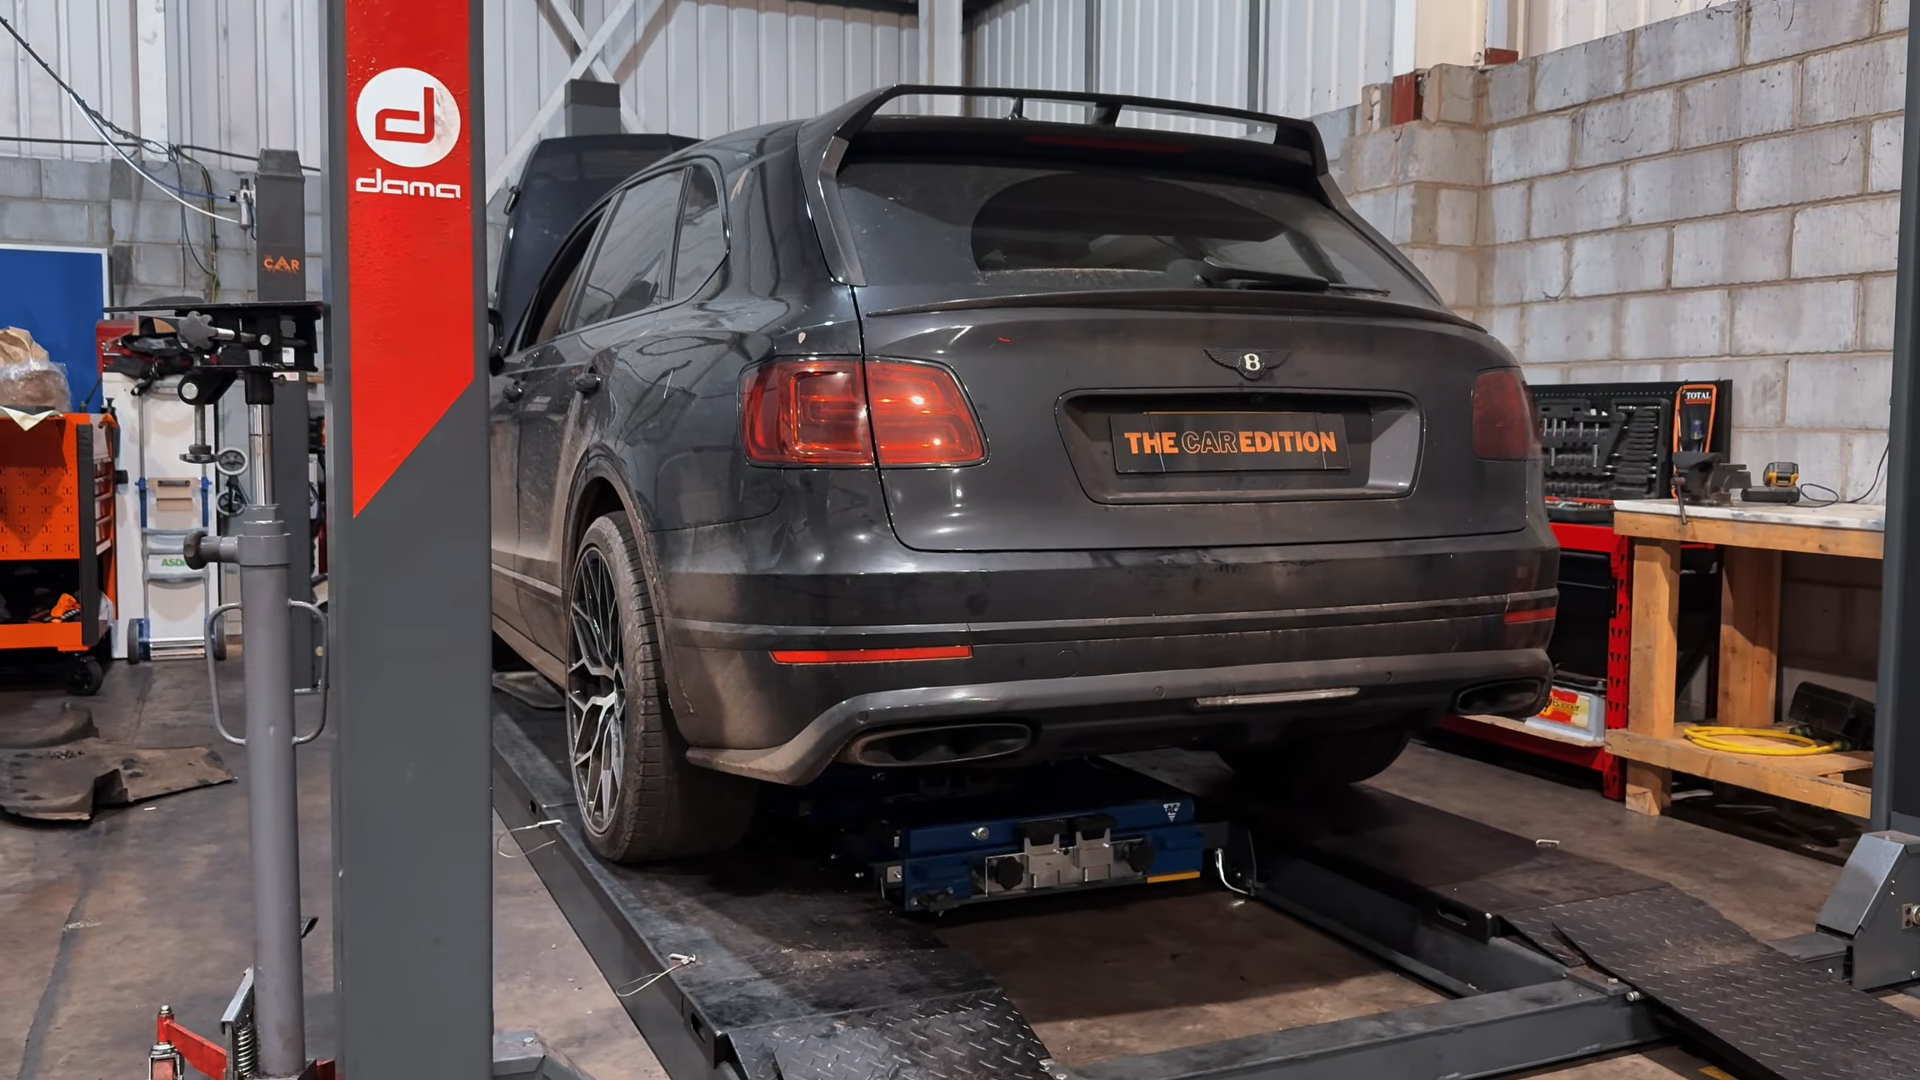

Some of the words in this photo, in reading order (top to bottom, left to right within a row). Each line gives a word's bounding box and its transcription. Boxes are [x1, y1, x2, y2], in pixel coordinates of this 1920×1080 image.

[356, 168, 461, 199] dama
[264, 256, 300, 270] CAR
[1243, 353, 1261, 371] B
[1685, 391, 1712, 400] TOTAL
[1124, 432, 1179, 454] THE
[1181, 430, 1238, 454] CAR
[1238, 431, 1338, 453] EDITION
[161, 558, 186, 567] ASD
[1552, 697, 1580, 712] Banner
